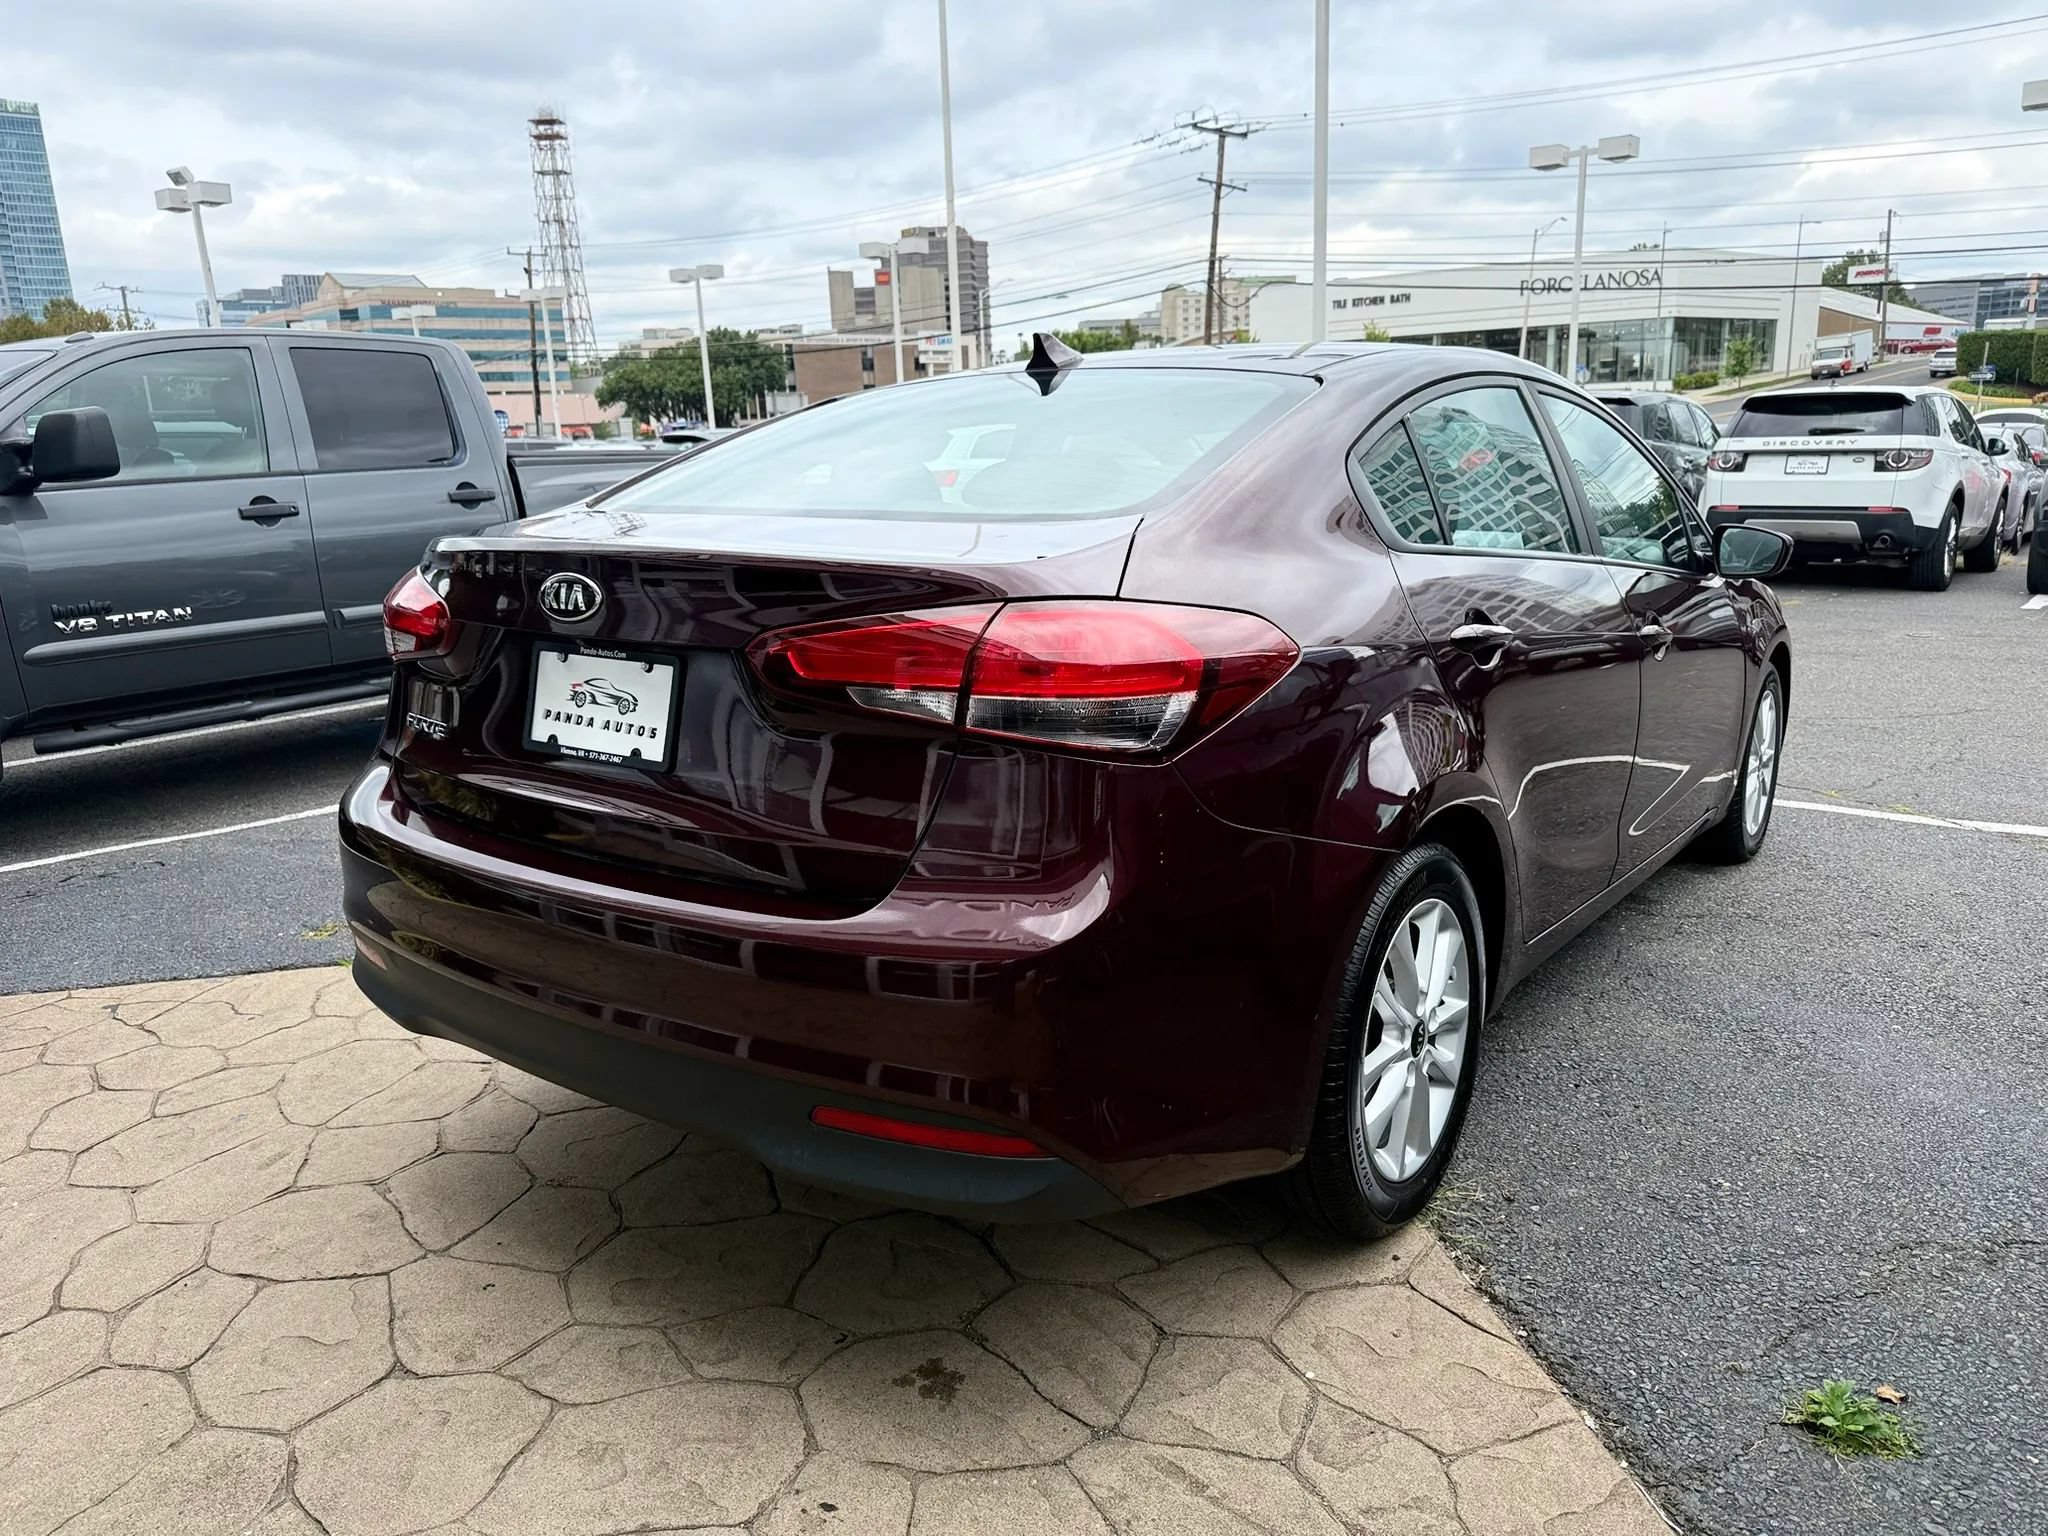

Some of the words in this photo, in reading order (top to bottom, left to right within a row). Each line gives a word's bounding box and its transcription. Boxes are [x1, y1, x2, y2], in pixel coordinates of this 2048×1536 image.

[1519, 268, 1663, 297] PORCLANOSA
[1332, 299, 1347, 310] TILE
[1352, 295, 1385, 308] KITCHEN
[1389, 292, 1411, 304] BATH
[1762, 438, 1858, 447] DISCOVERY
[544, 581, 587, 612] KIA
[53, 616, 98, 635] V8
[104, 606, 192, 629] TITAN
[579, 646, 627, 659] Panda-Autos.Com
[542, 707, 594, 729] PANDA
[599, 719, 658, 740] AUTOS
